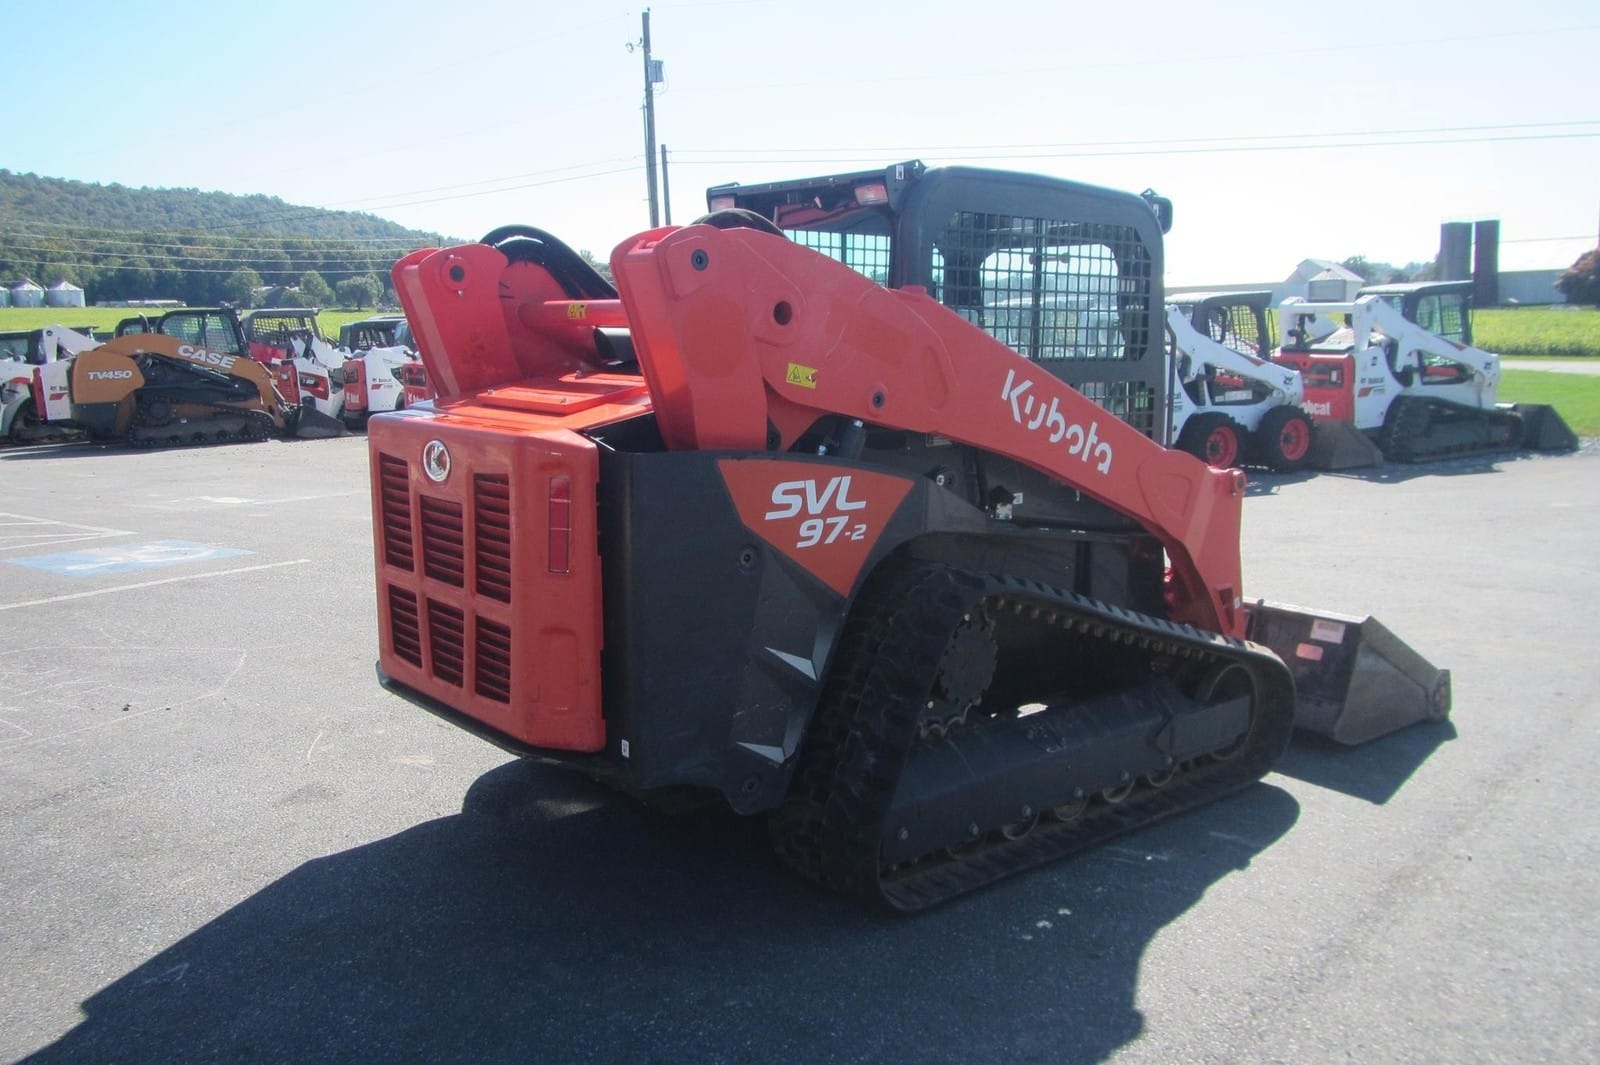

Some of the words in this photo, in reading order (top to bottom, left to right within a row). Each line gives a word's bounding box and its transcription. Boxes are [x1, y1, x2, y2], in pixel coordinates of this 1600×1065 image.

[177, 344, 240, 369] CASE
[88, 370, 133, 380] TV450
[1001, 369, 1112, 474] Kubota
[1299, 399, 1331, 416] obcat
[765, 475, 867, 521] SVL
[796, 516, 867, 549] 97-2
